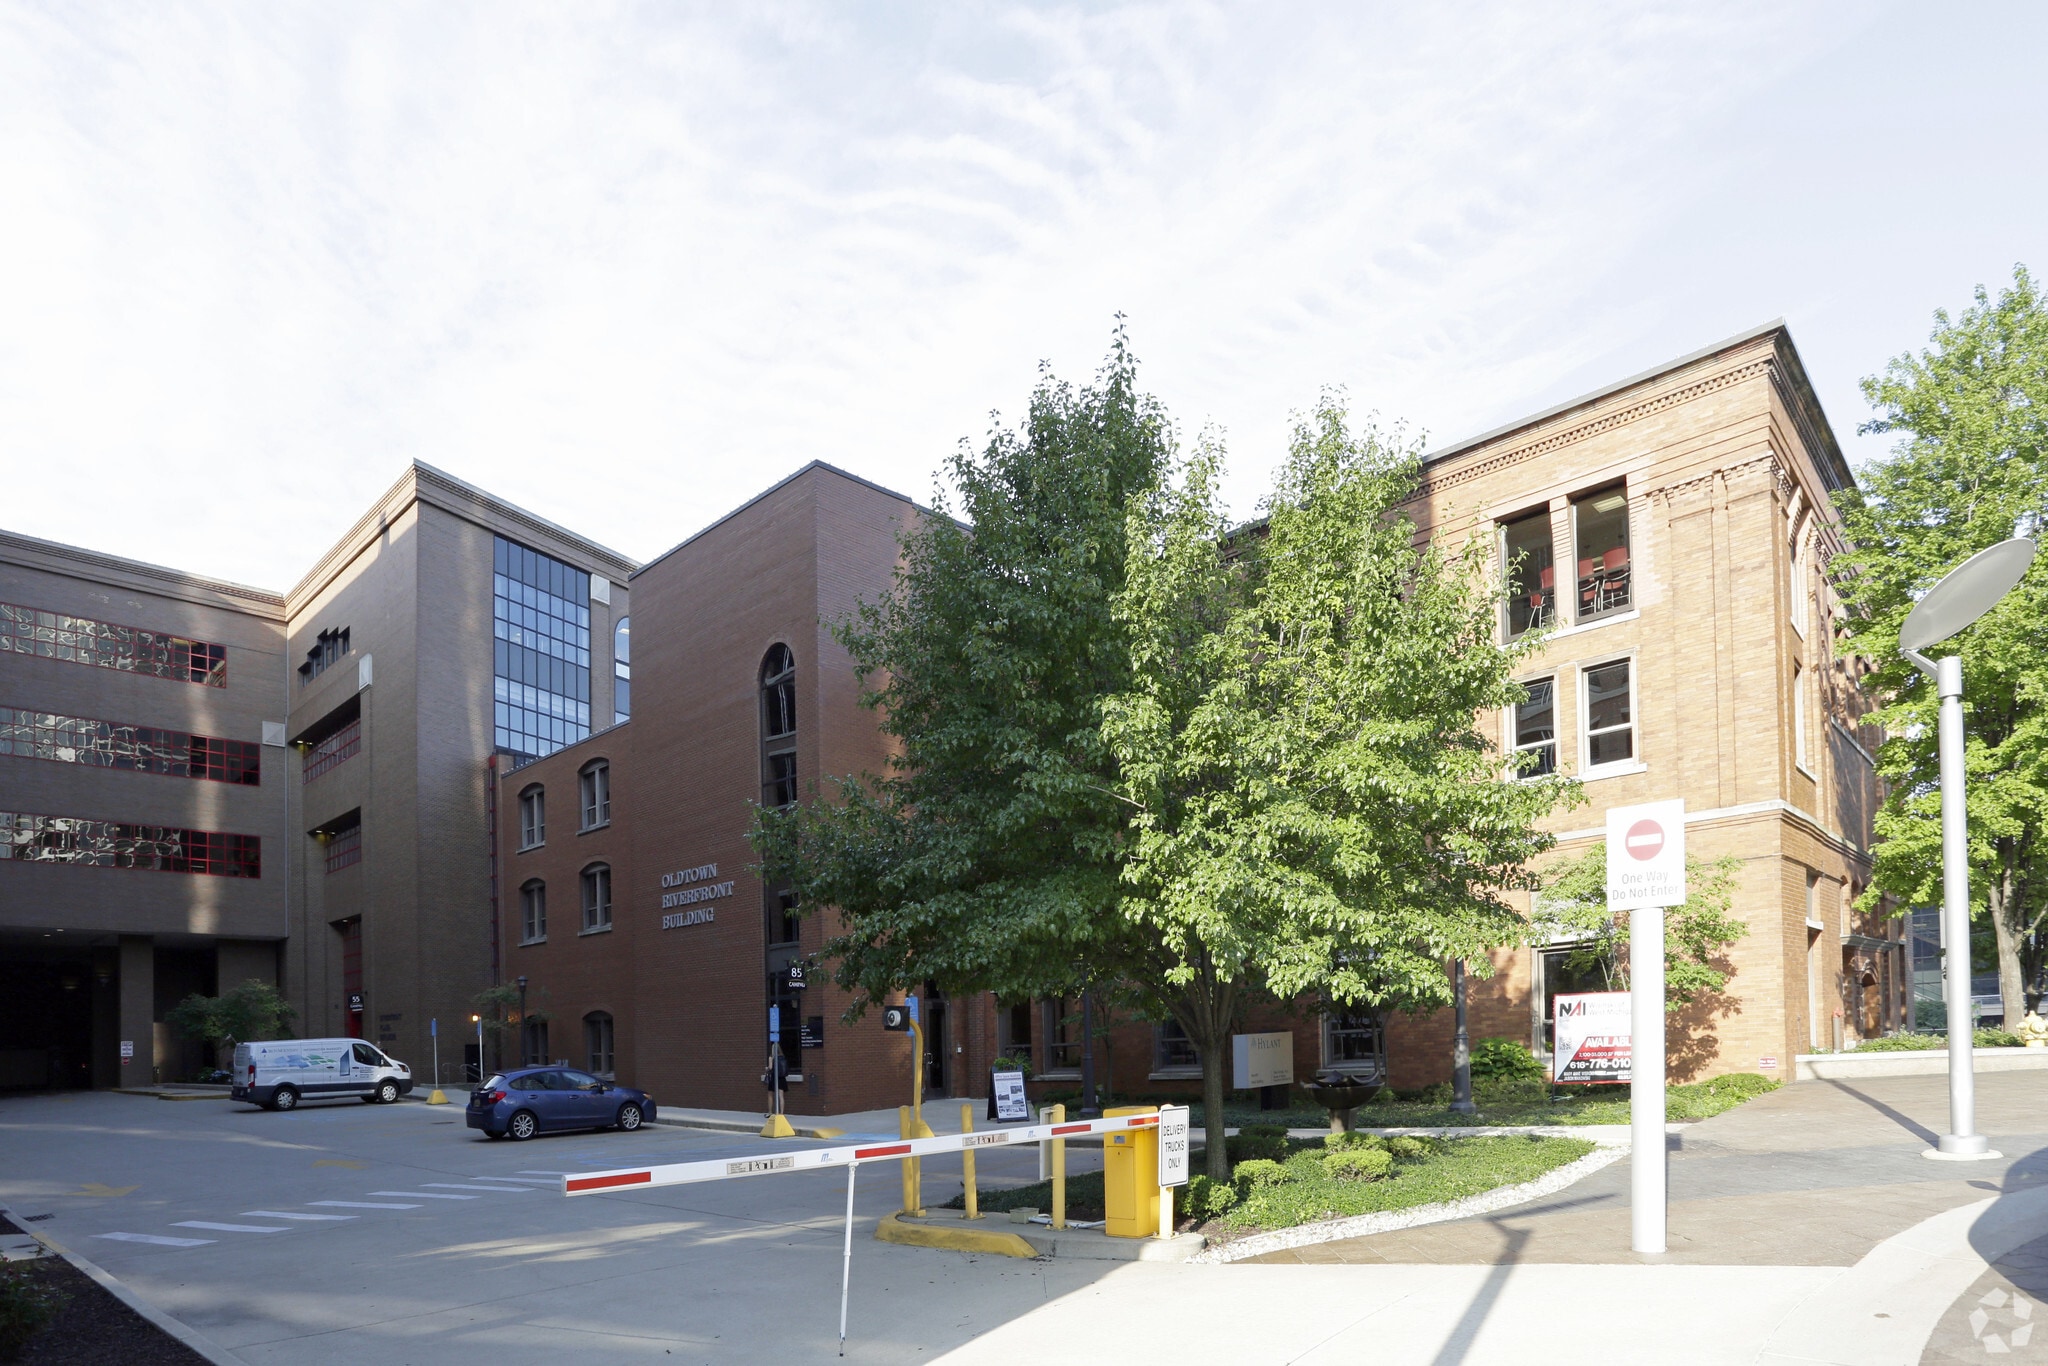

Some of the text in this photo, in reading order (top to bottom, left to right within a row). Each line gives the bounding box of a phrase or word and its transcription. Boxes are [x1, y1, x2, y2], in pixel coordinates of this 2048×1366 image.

[662, 863, 718, 888] OLDTOWN
[1621, 870, 1669, 885] One Way
[662, 881, 735, 909] RIVERFRONT
[1612, 886, 1678, 900] Do Not Enter
[662, 907, 715, 930] BUILDING
[791, 967, 802, 978] 85
[352, 995, 360, 1003] 55
[1559, 1000, 1586, 1017] NAI
[1585, 1036, 1631, 1048] AVAILABL
[1569, 1058, 1632, 1069] 616-776-010
[1163, 1124, 1186, 1136] DELIVERY
[1165, 1140, 1184, 1152] TRUCKS
[1168, 1157, 1181, 1169] ONLY
